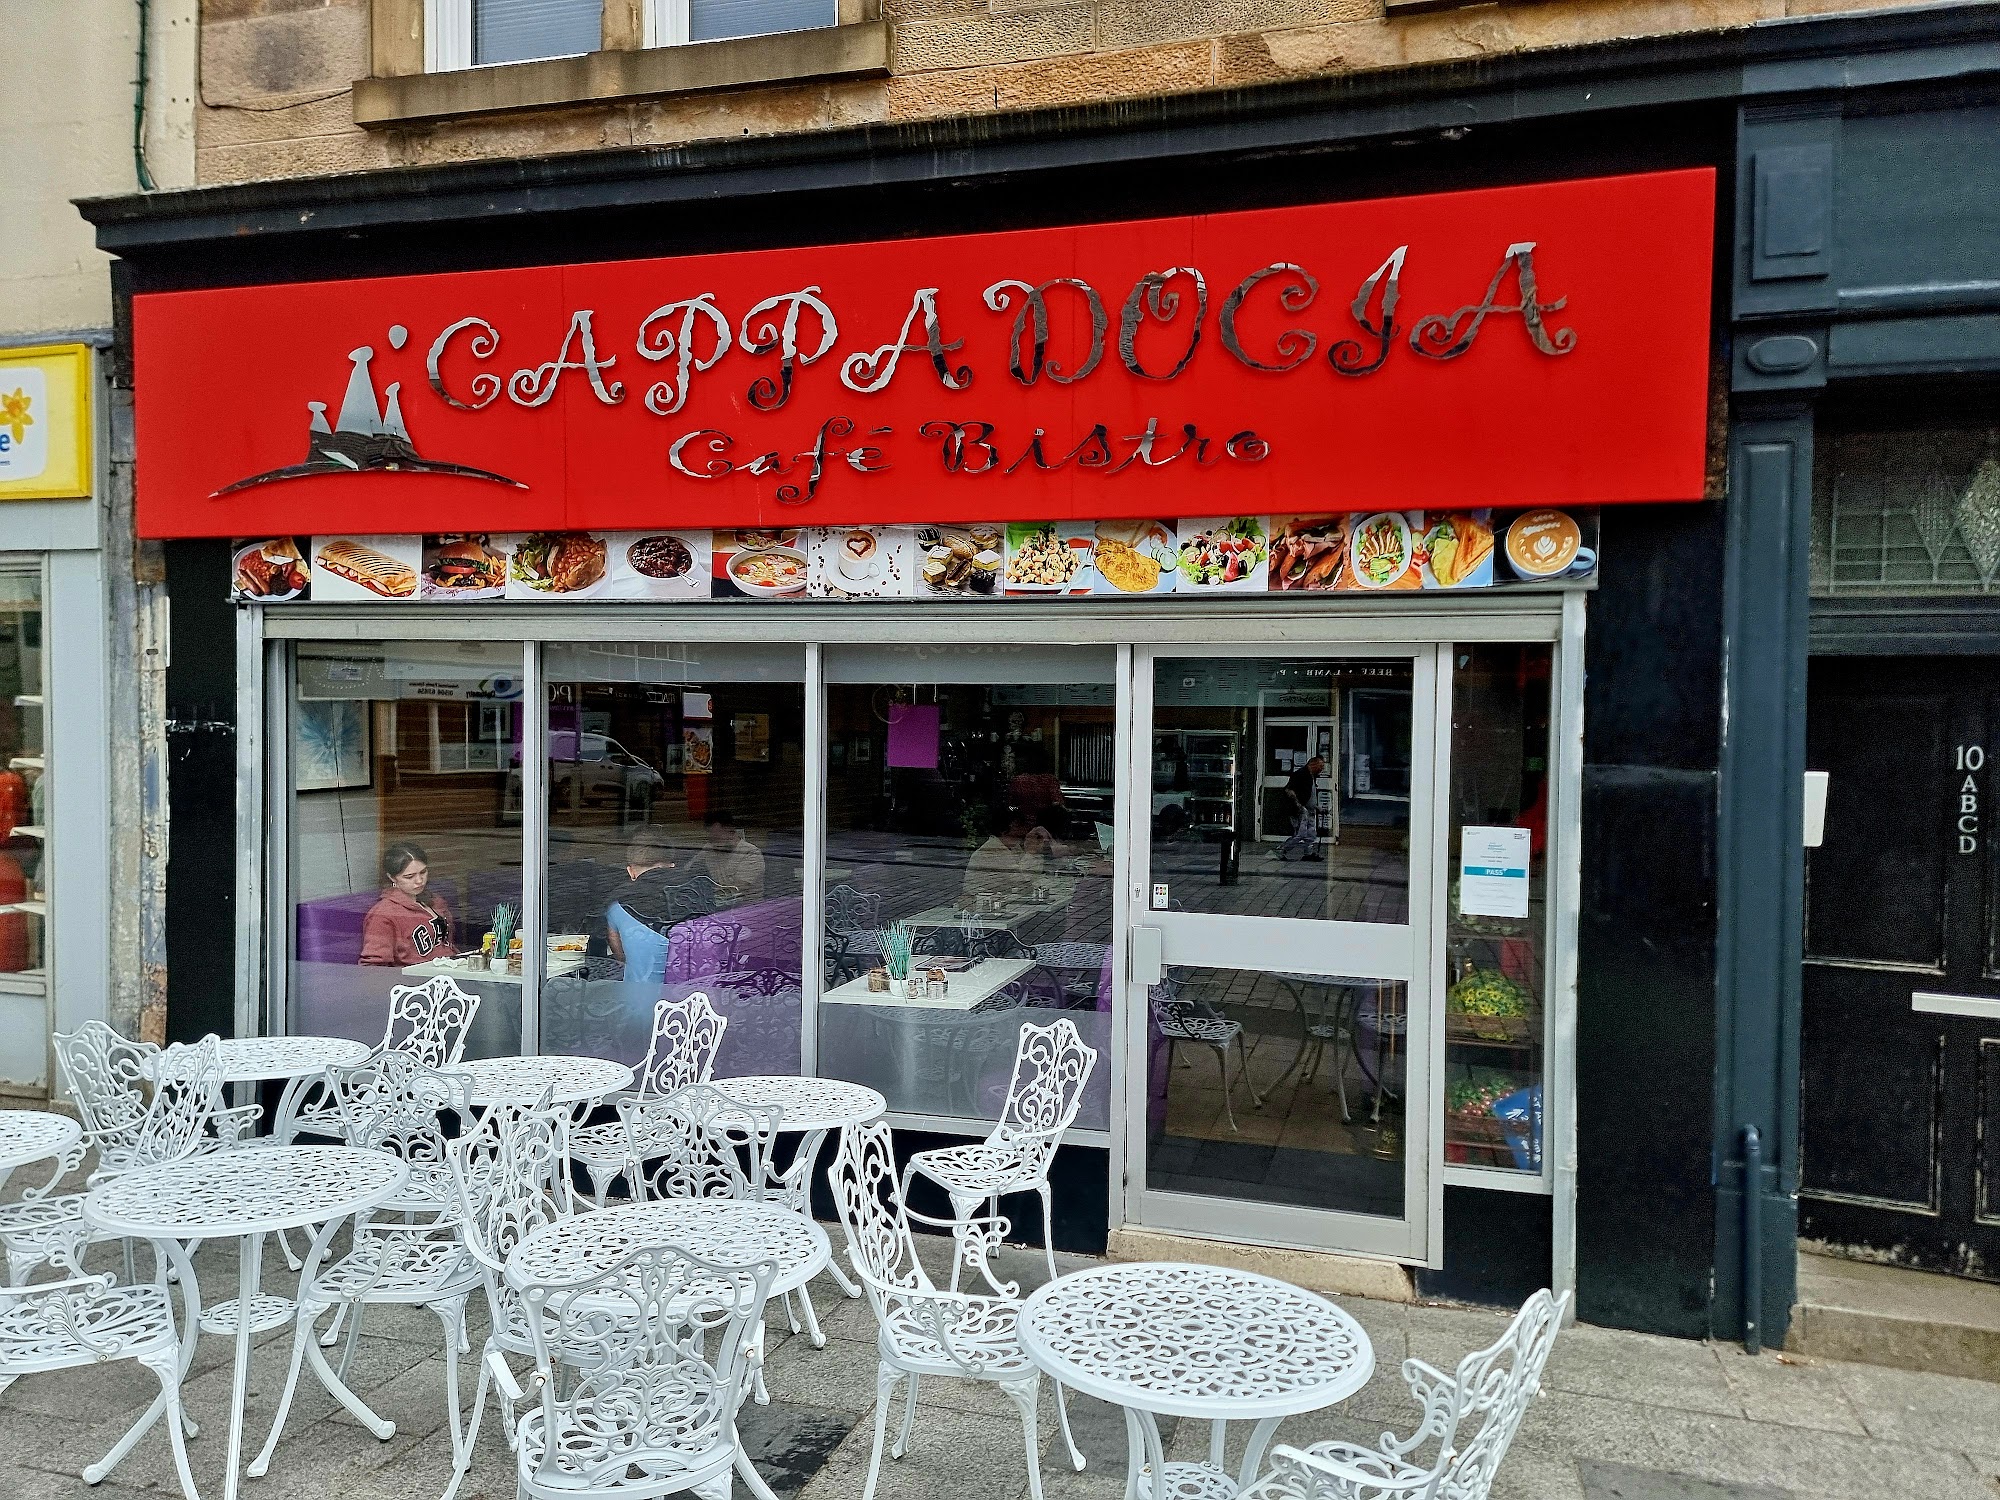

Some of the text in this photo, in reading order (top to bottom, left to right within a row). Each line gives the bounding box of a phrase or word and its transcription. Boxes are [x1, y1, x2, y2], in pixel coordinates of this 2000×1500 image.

[427, 241, 1578, 415] CAPPADOCIA
[669, 416, 1272, 505] Café Bistro
[1955, 745, 1985, 771] 10
